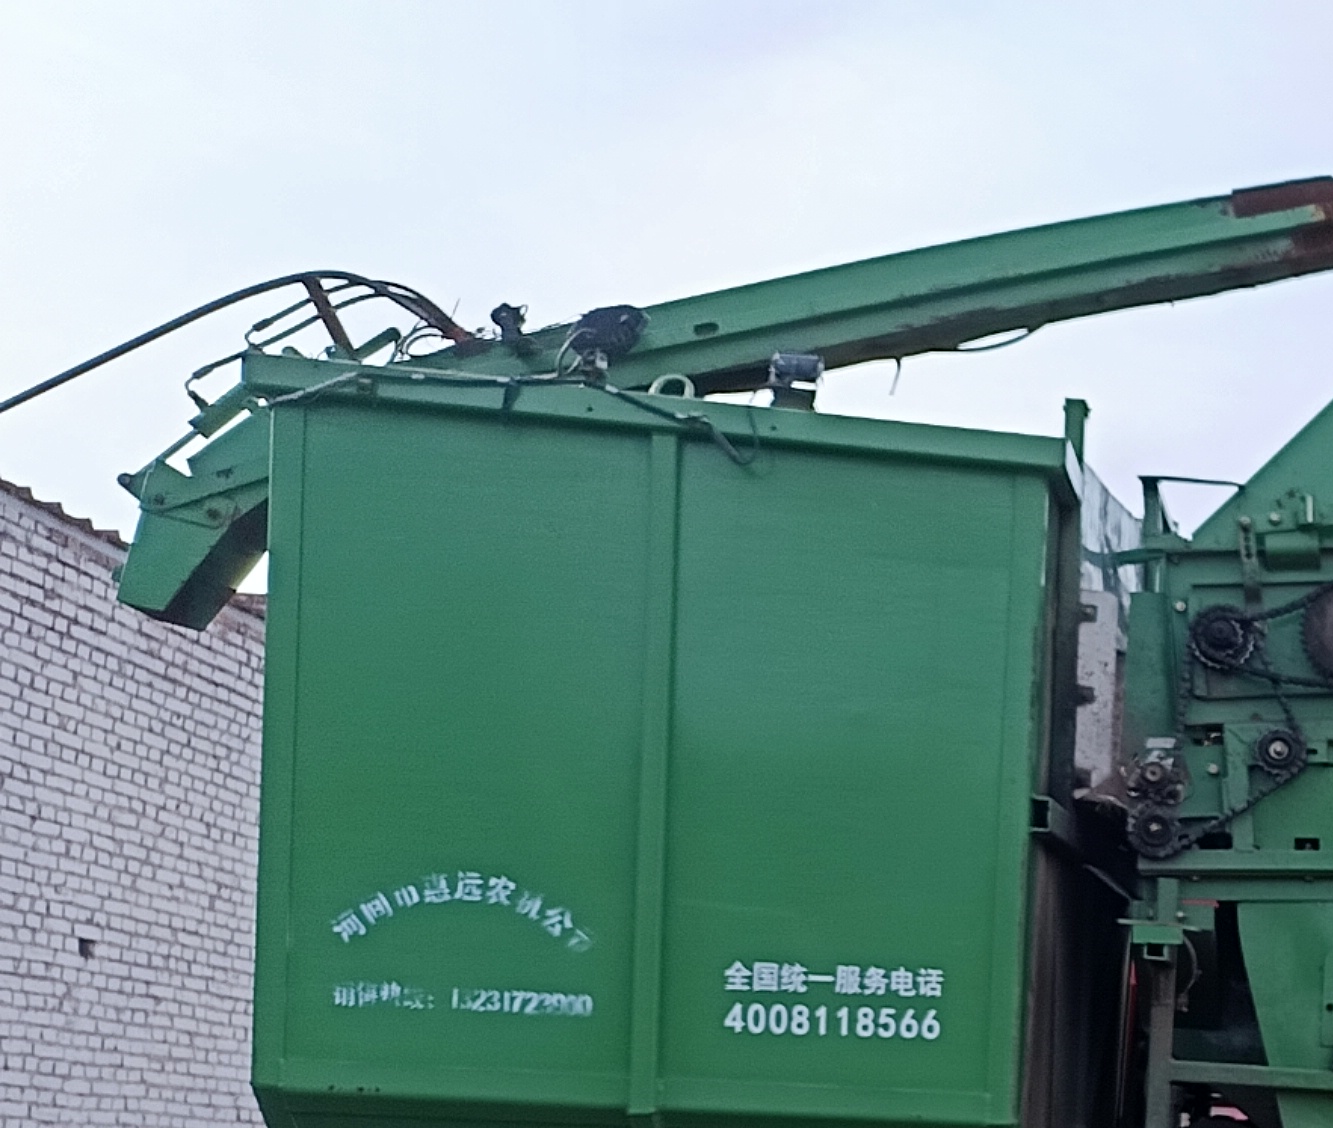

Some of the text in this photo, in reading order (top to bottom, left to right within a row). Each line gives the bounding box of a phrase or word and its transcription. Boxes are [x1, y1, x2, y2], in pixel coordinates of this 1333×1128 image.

[723, 960, 944, 998] 全国统一服务电话
[723, 1002, 941, 1040] 4008118566
